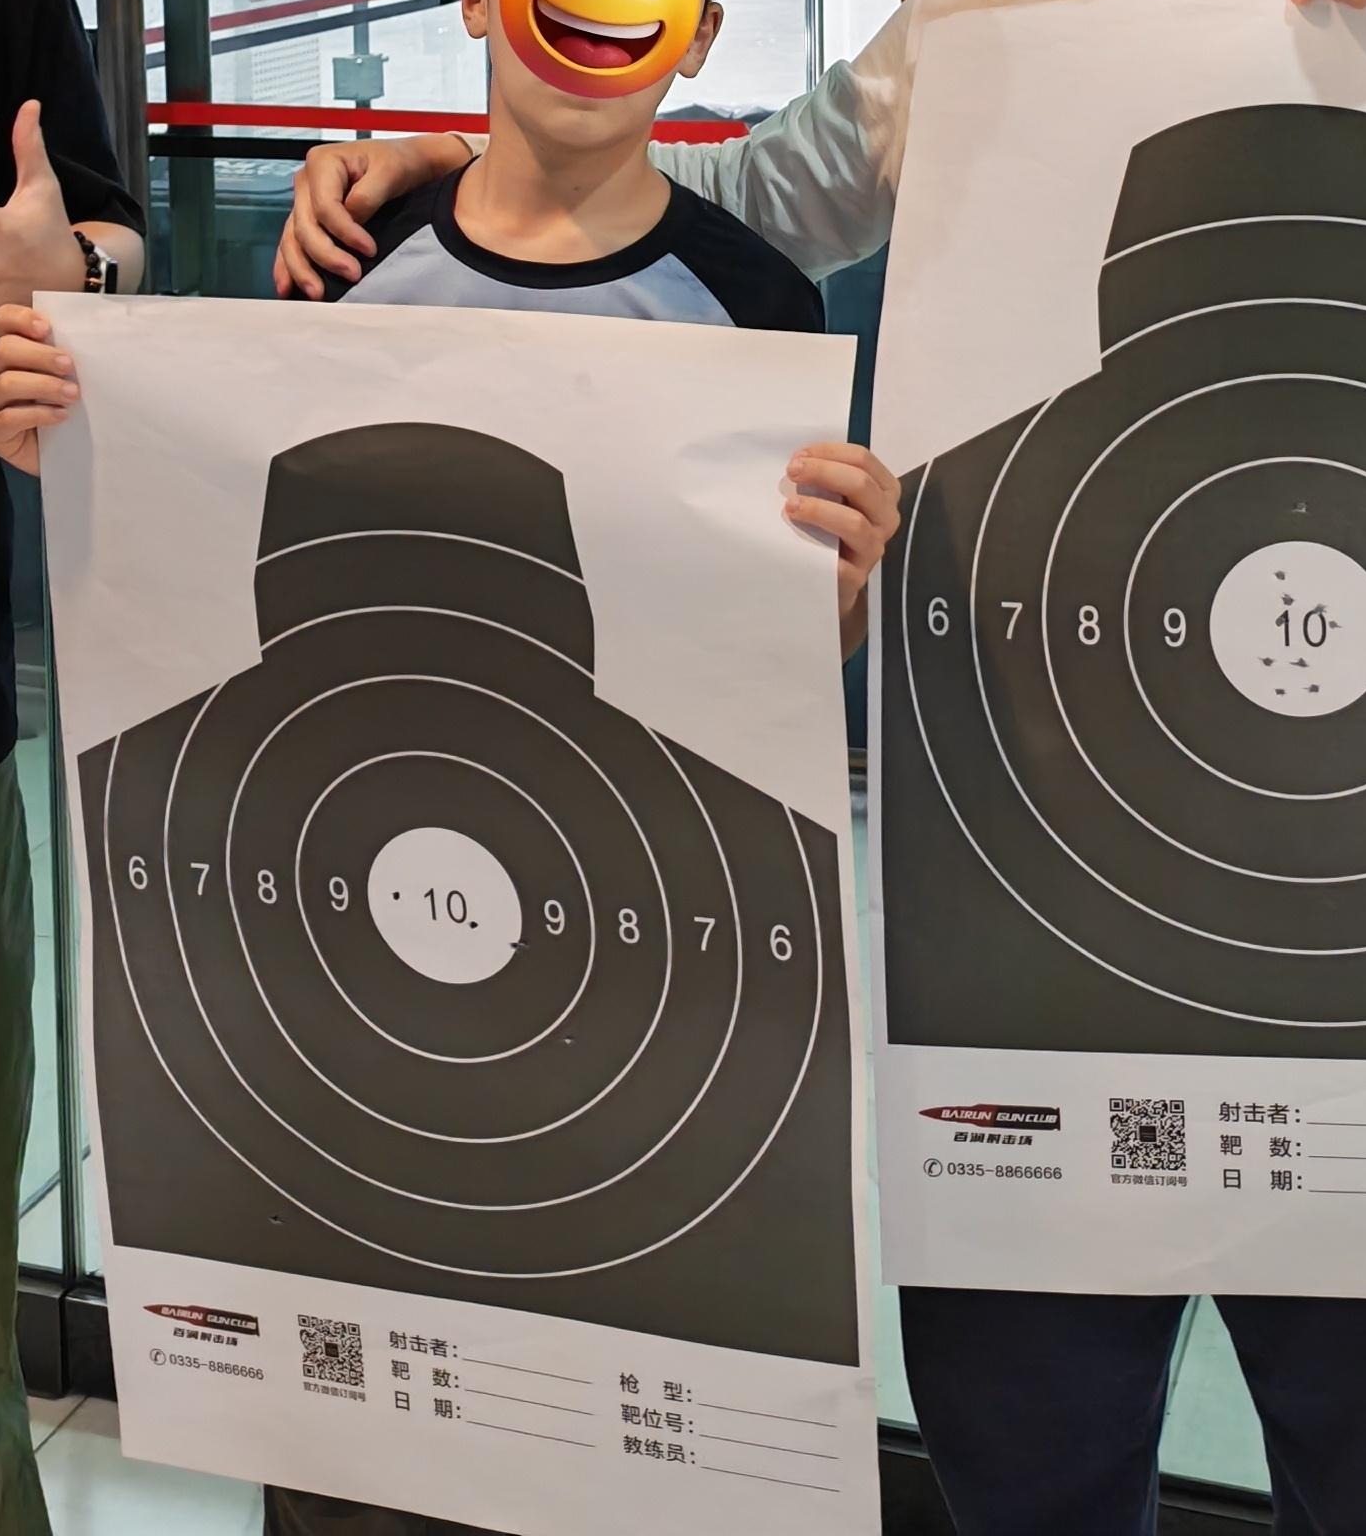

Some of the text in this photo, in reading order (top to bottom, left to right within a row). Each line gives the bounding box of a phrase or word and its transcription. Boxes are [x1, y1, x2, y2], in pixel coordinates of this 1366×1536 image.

[927, 597, 950, 636] 6
[1000, 601, 1023, 640] 7
[1077, 605, 1101, 646] 8
[1162, 607, 1187, 648] 9
[127, 856, 149, 890] 6
[190, 863, 210, 895] 7
[257, 869, 278, 904] 8
[328, 876, 350, 912] 9
[543, 899, 566, 935] 9
[617, 908, 640, 944] 8
[693, 917, 716, 951] 7
[770, 924, 793, 960] 6
[940, 1109, 992, 1121] BAIRUN
[1218, 1102, 1301, 1125] 射击者：
[947, 1162, 1062, 1180] 0335-8866666
[389, 1330, 458, 1358] 射击者：
[169, 1353, 264, 1381] 0335-8866666
[620, 1403, 694, 1434] 靶位号：
[622, 1434, 697, 1465] 教练员：
